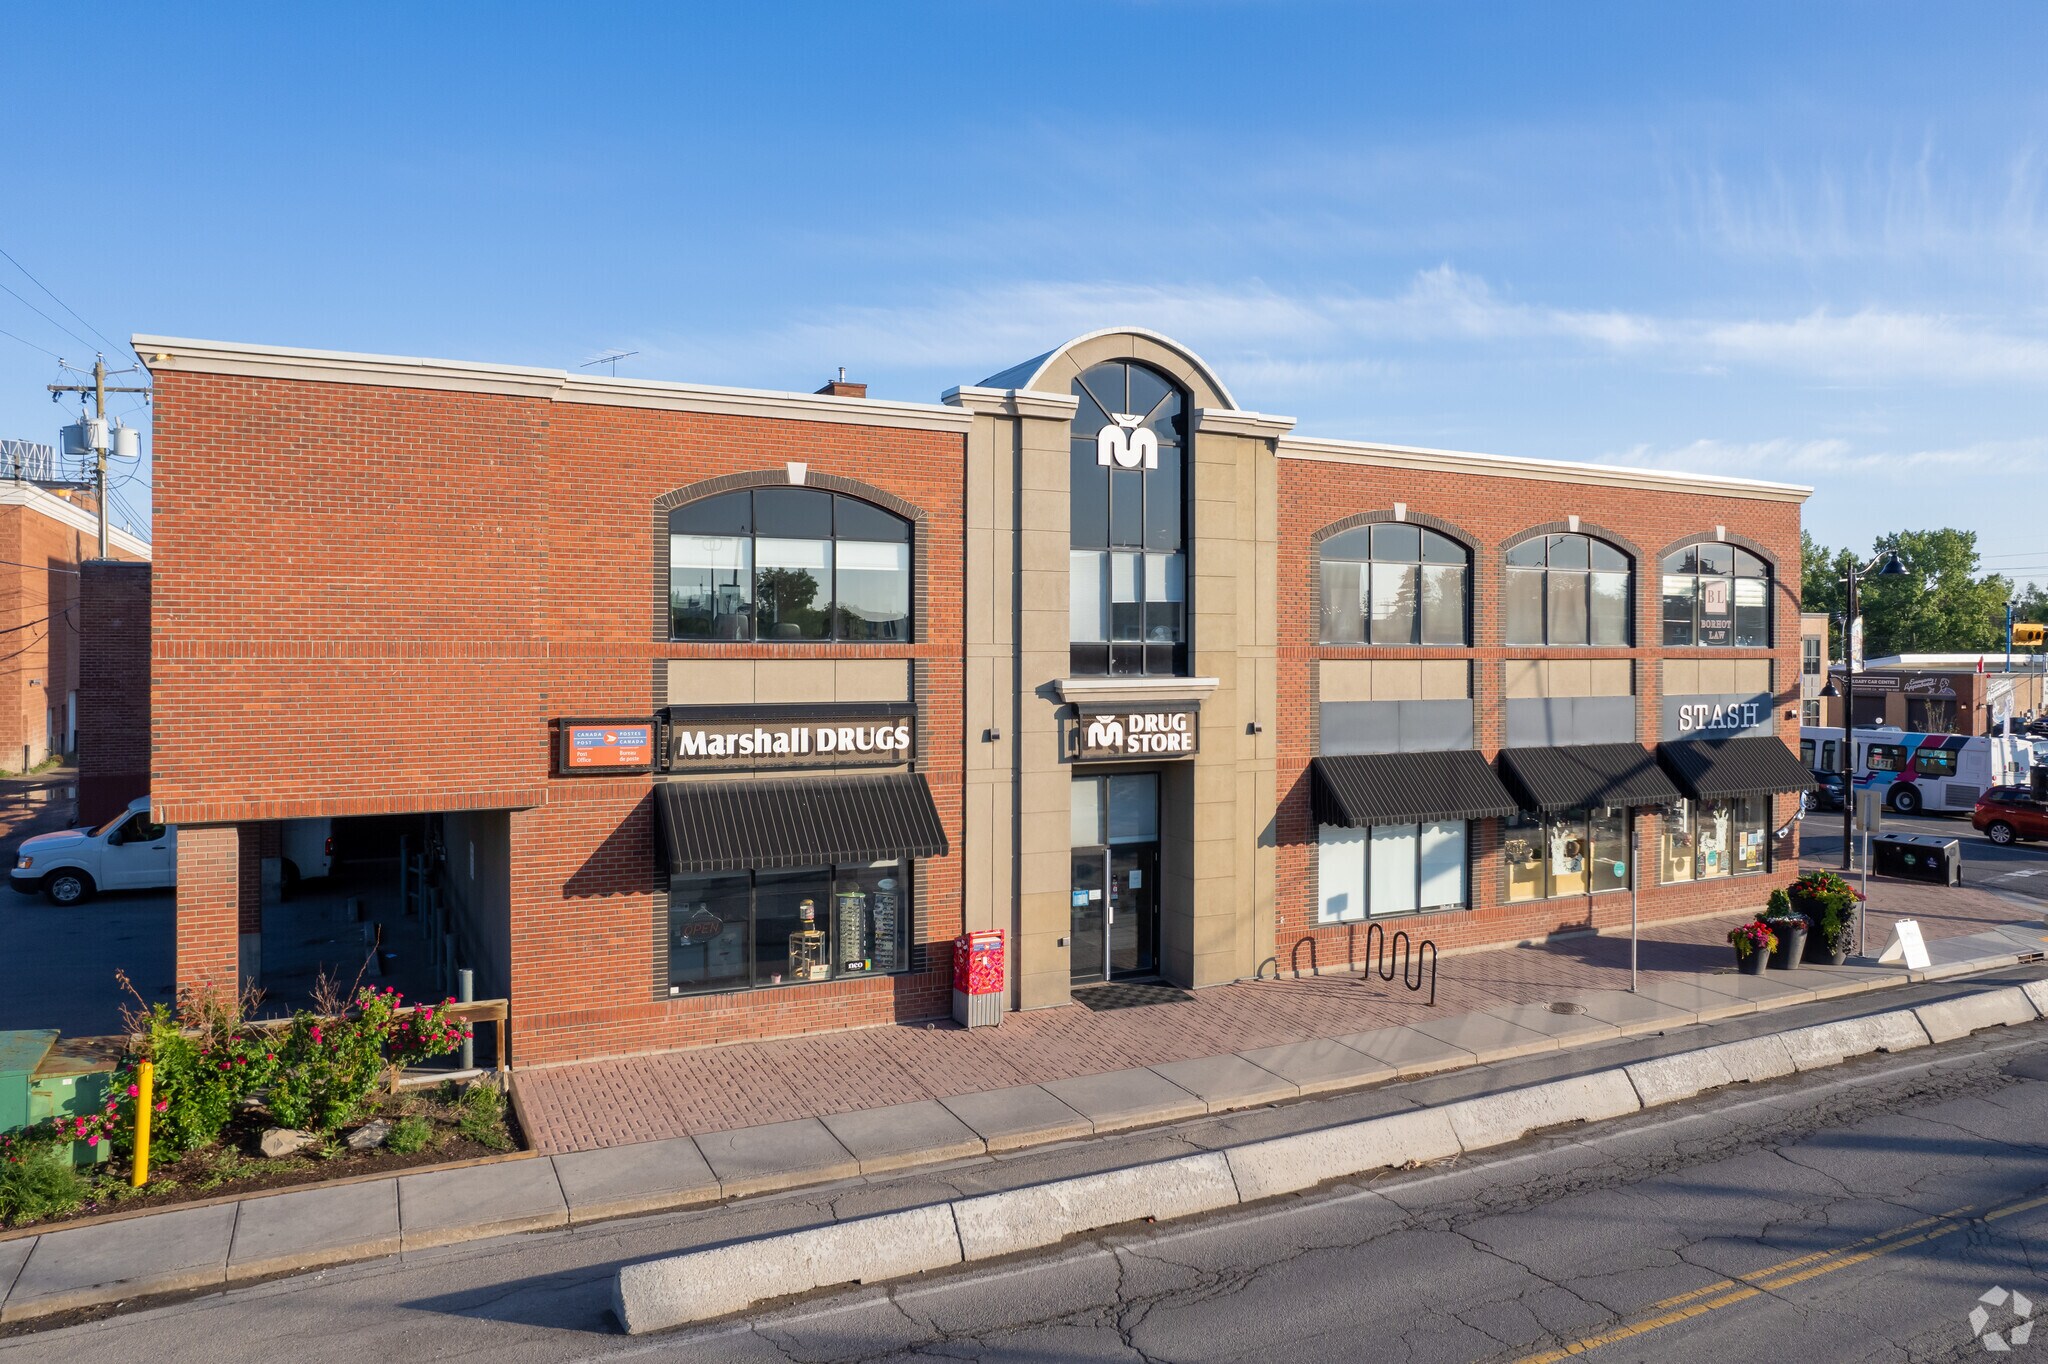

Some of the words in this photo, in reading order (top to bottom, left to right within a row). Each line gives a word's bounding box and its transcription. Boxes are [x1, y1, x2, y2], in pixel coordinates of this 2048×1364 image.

[1701, 619, 1731, 628] BORHOT
[1708, 630, 1725, 639] LAW
[1128, 713, 1187, 733] DRUG
[1678, 703, 1760, 731] STASH
[679, 728, 809, 756] Marshall
[817, 726, 910, 752] DRUGS
[1127, 731, 1192, 753] STORE
[684, 922, 719, 936] OPEN
[848, 961, 863, 969] neo
